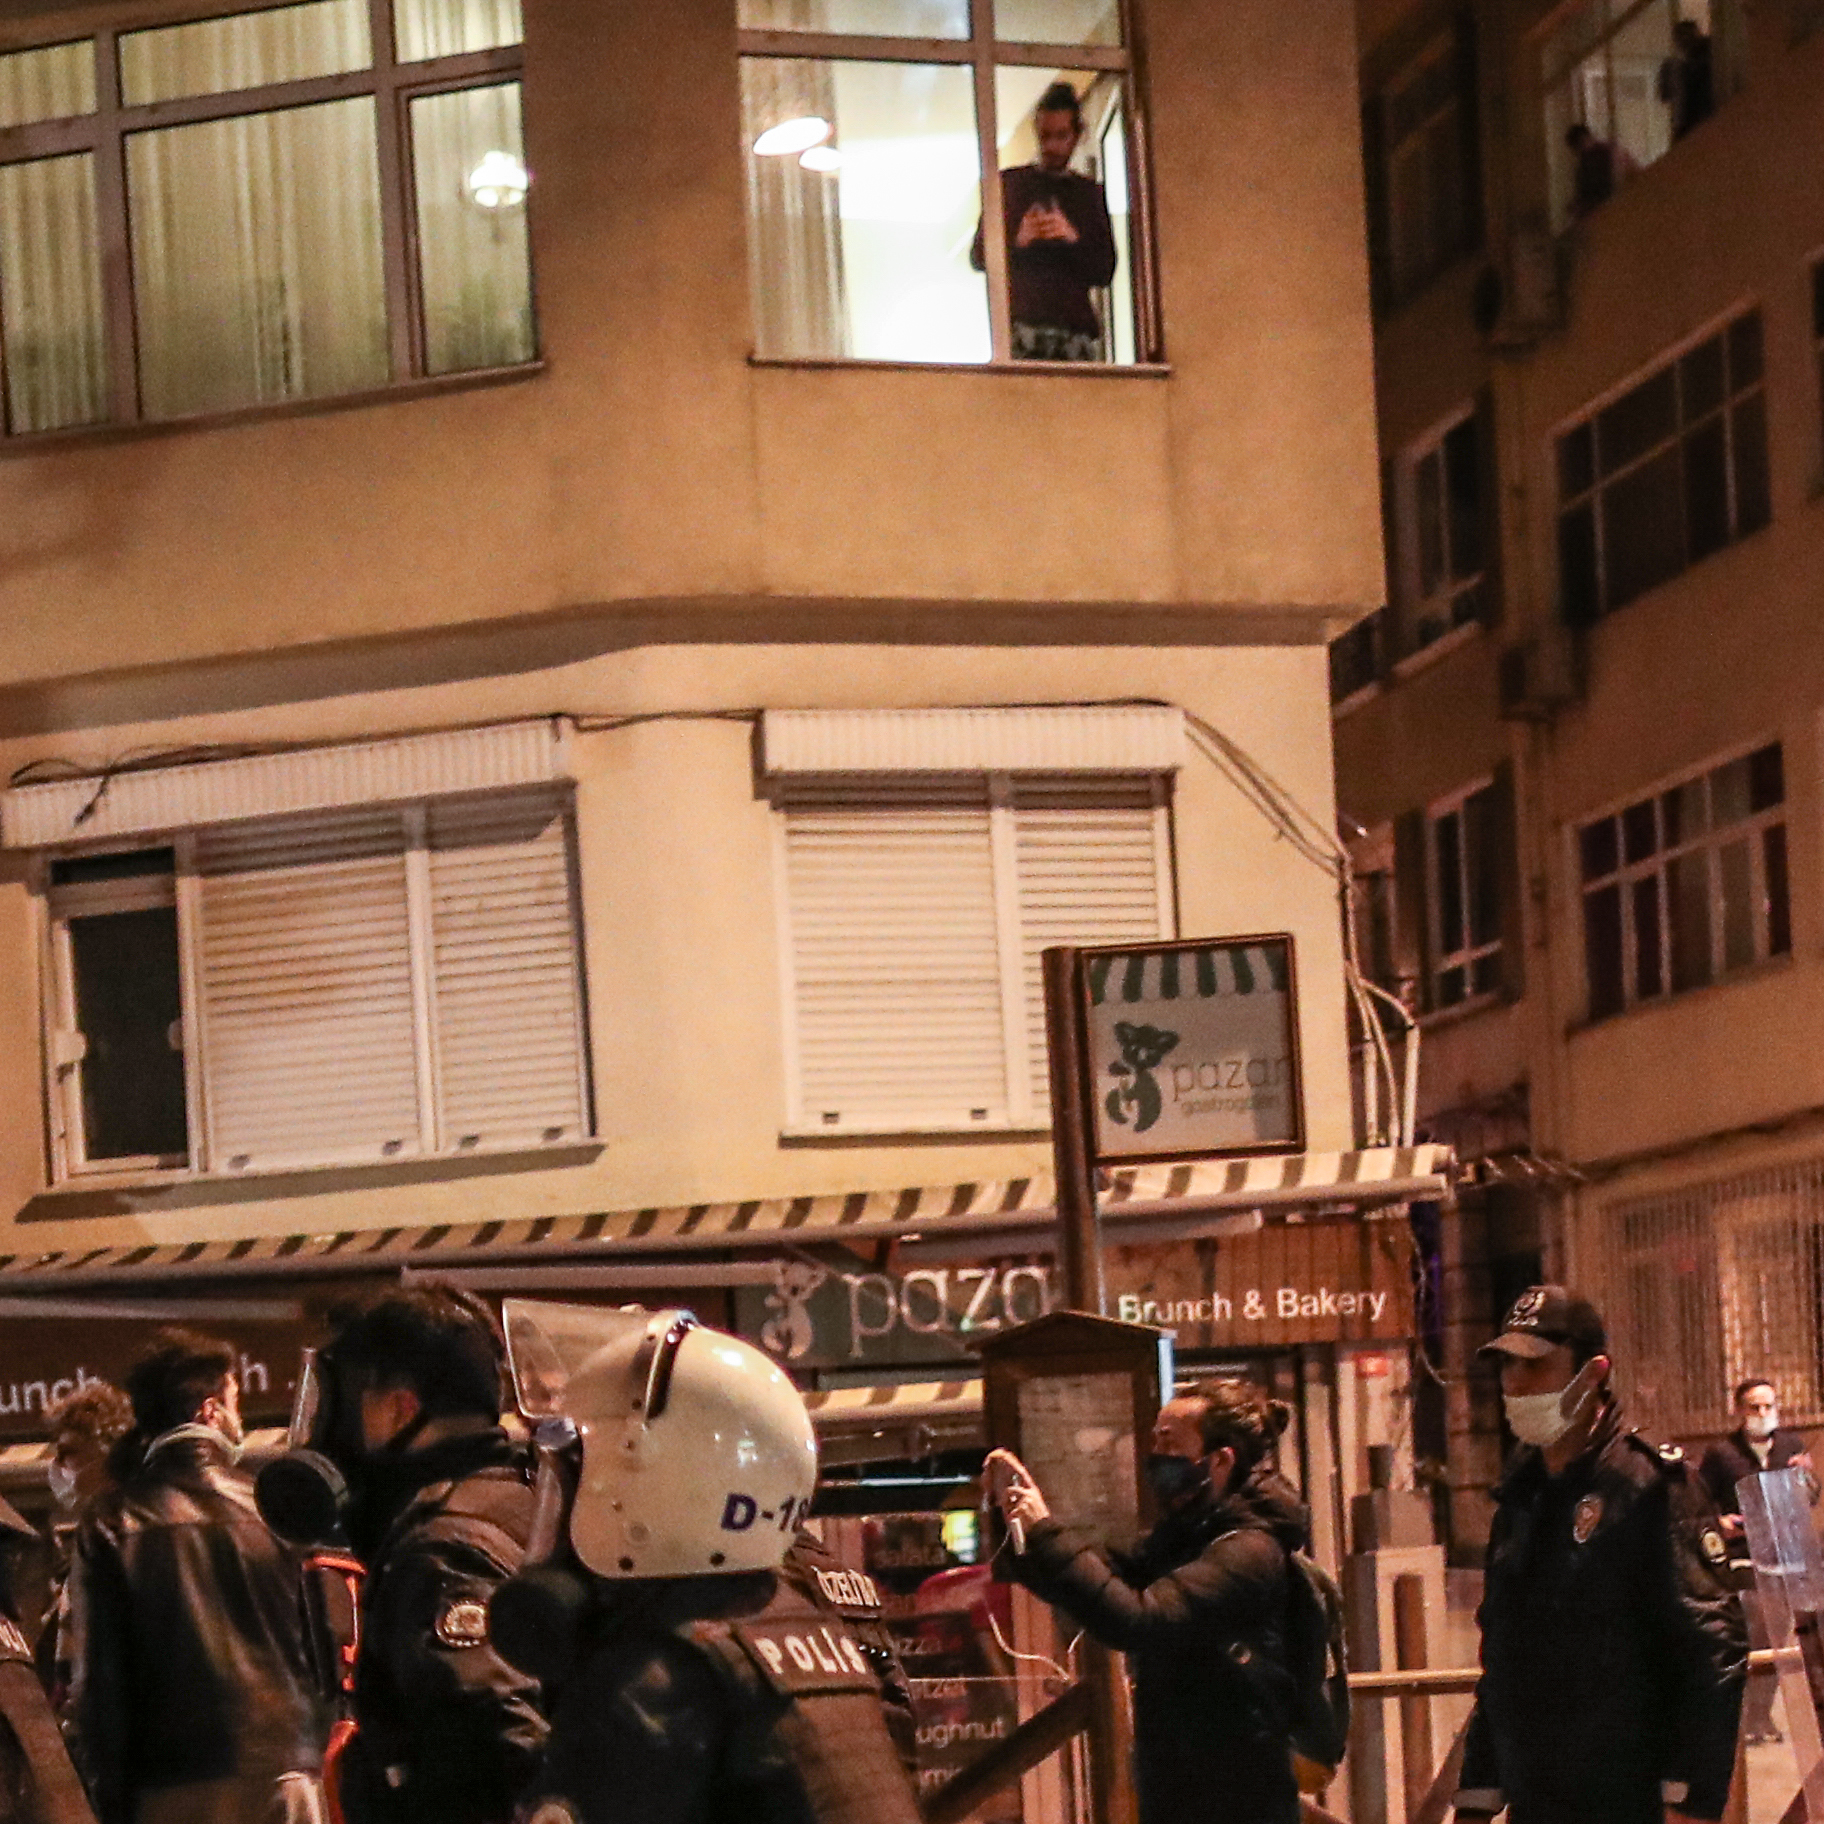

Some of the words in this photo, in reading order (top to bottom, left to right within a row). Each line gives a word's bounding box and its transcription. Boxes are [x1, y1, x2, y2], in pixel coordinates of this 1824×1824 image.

[1118, 1292, 1233, 1324] Brunch
[1242, 1288, 1268, 1321] &
[1277, 1286, 1387, 1322] Bakery
